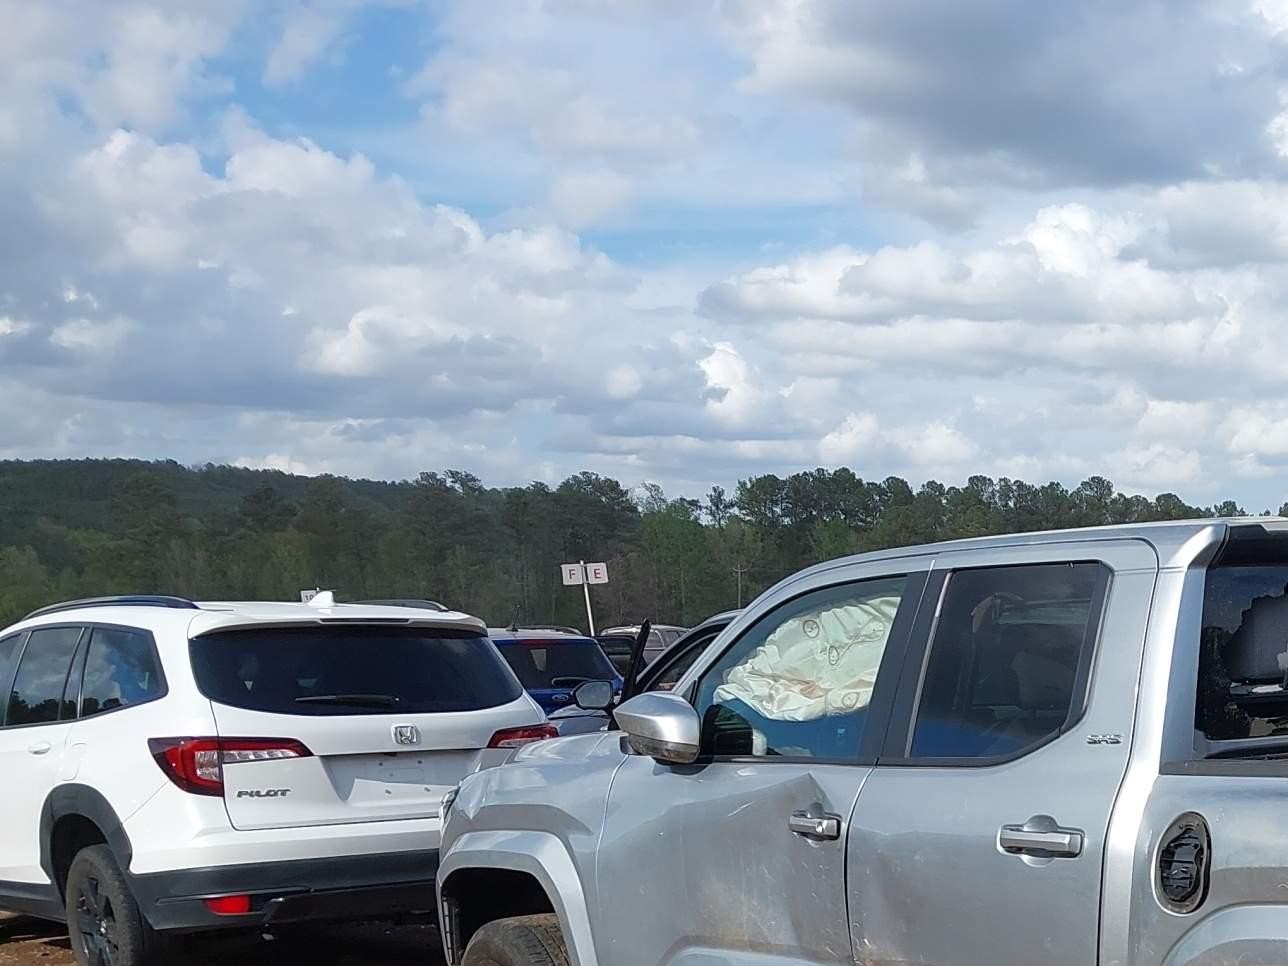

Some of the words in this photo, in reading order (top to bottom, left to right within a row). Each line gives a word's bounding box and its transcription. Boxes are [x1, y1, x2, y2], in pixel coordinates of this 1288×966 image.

[568, 568, 576, 580] F
[593, 567, 602, 580] E
[236, 788, 291, 798] PILOT
